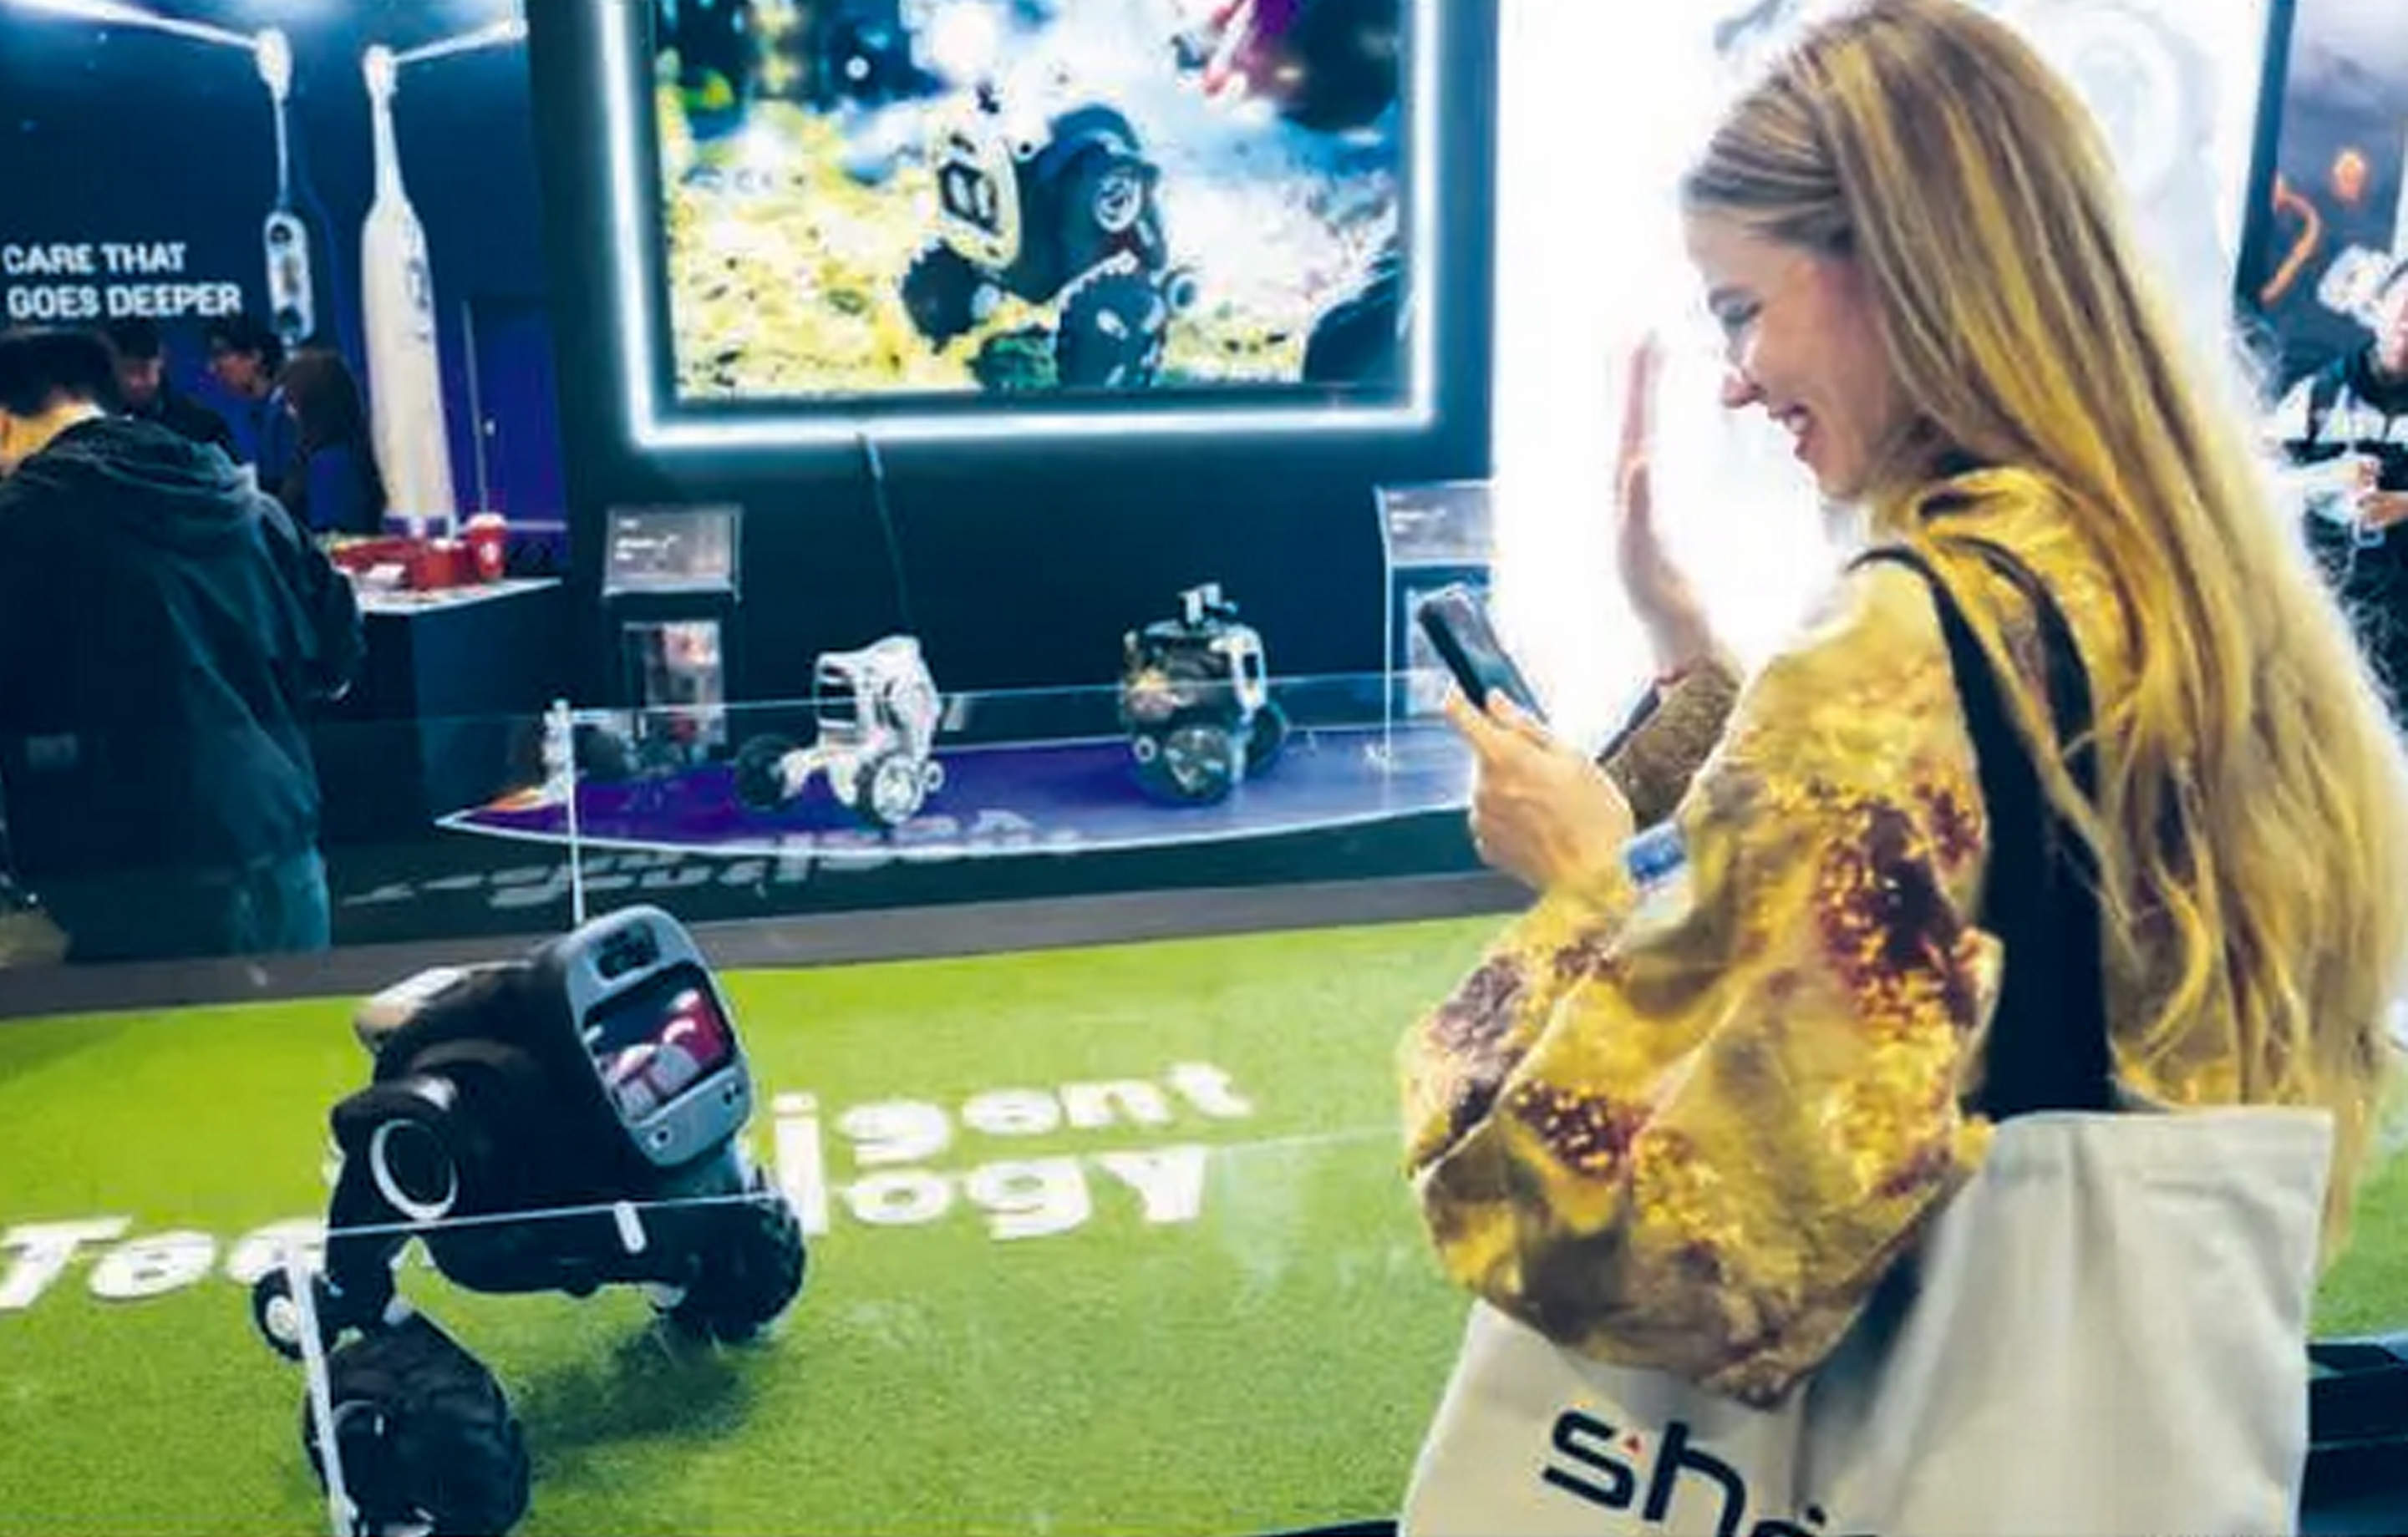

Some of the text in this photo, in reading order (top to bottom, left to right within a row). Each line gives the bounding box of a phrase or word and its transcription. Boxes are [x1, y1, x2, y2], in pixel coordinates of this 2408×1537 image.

[3, 242, 186, 275] CARE THAT
[8, 283, 242, 318] GOES DEEPER
